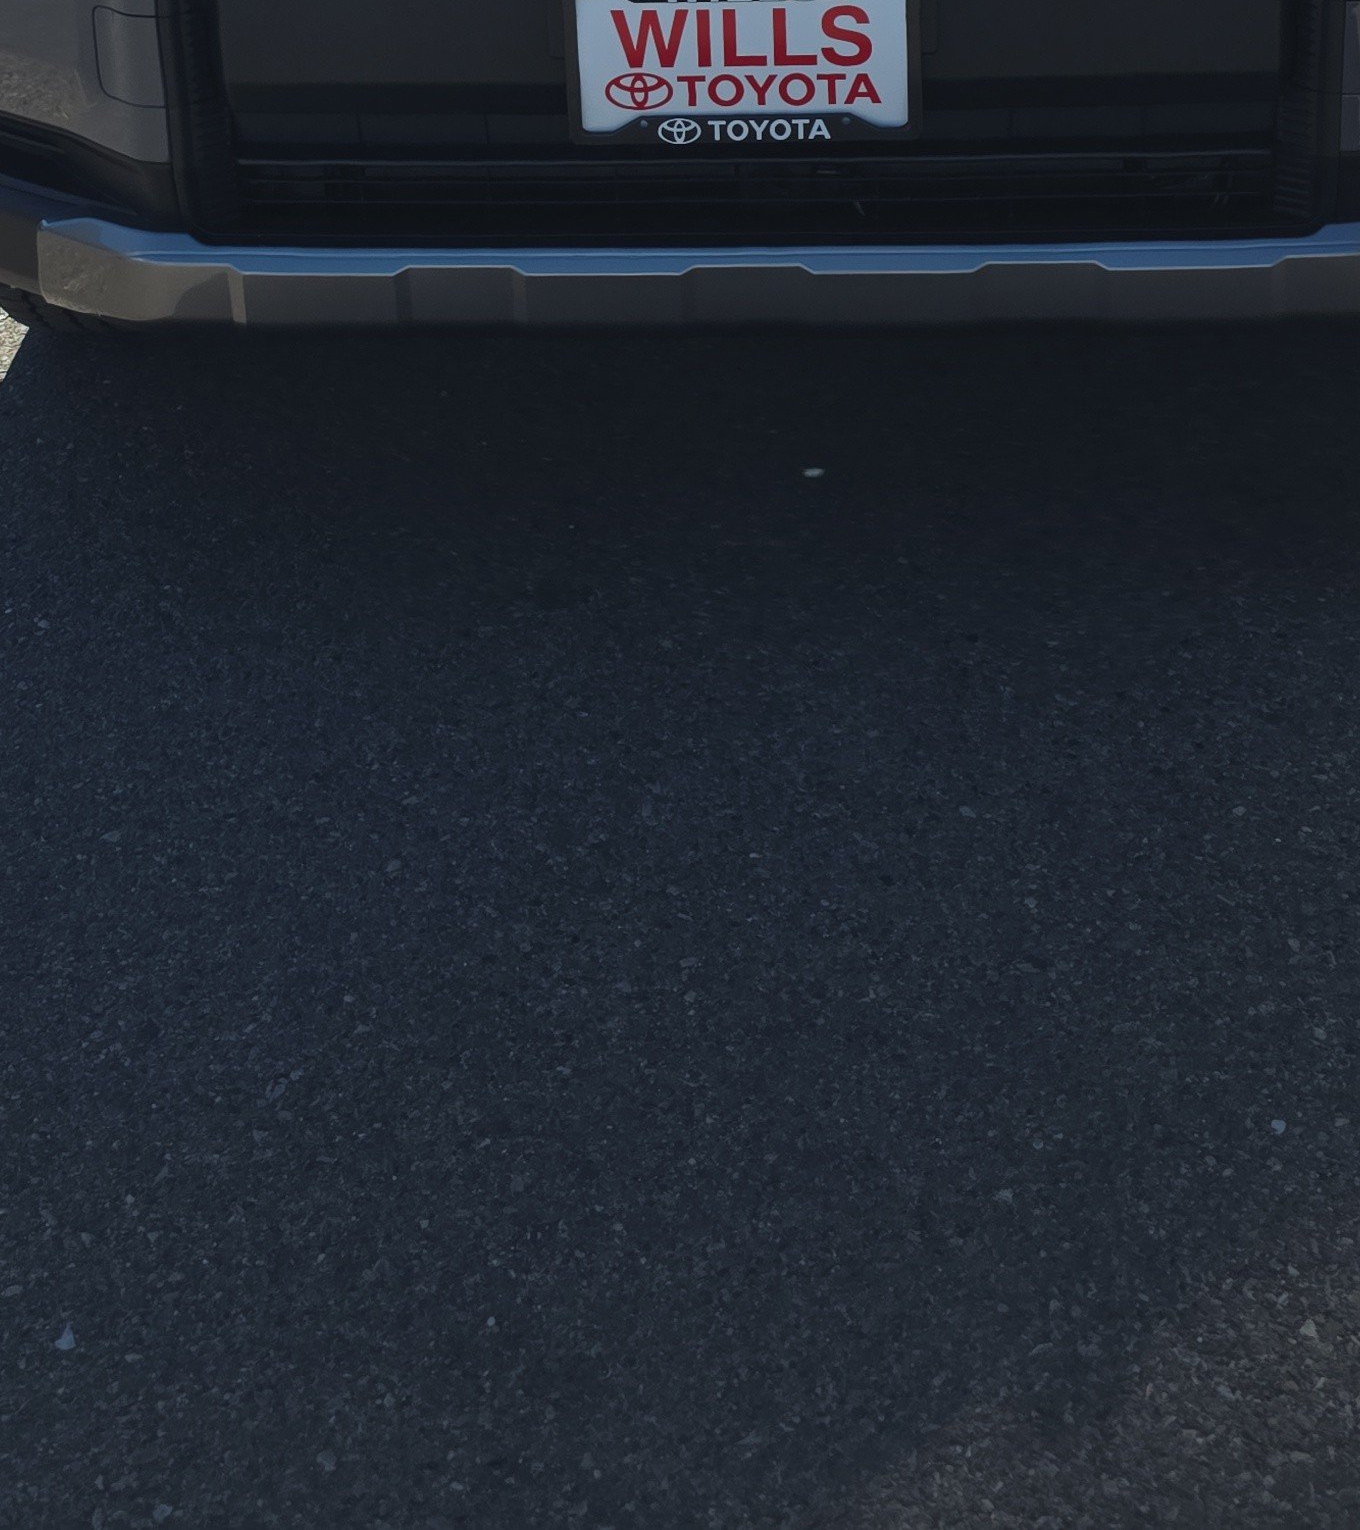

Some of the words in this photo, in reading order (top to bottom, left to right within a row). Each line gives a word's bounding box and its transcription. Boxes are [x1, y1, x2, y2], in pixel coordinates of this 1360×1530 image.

[610, 5, 873, 68] WILLS
[676, 72, 883, 107] TOYOTA
[707, 118, 831, 141] TOYOTA
